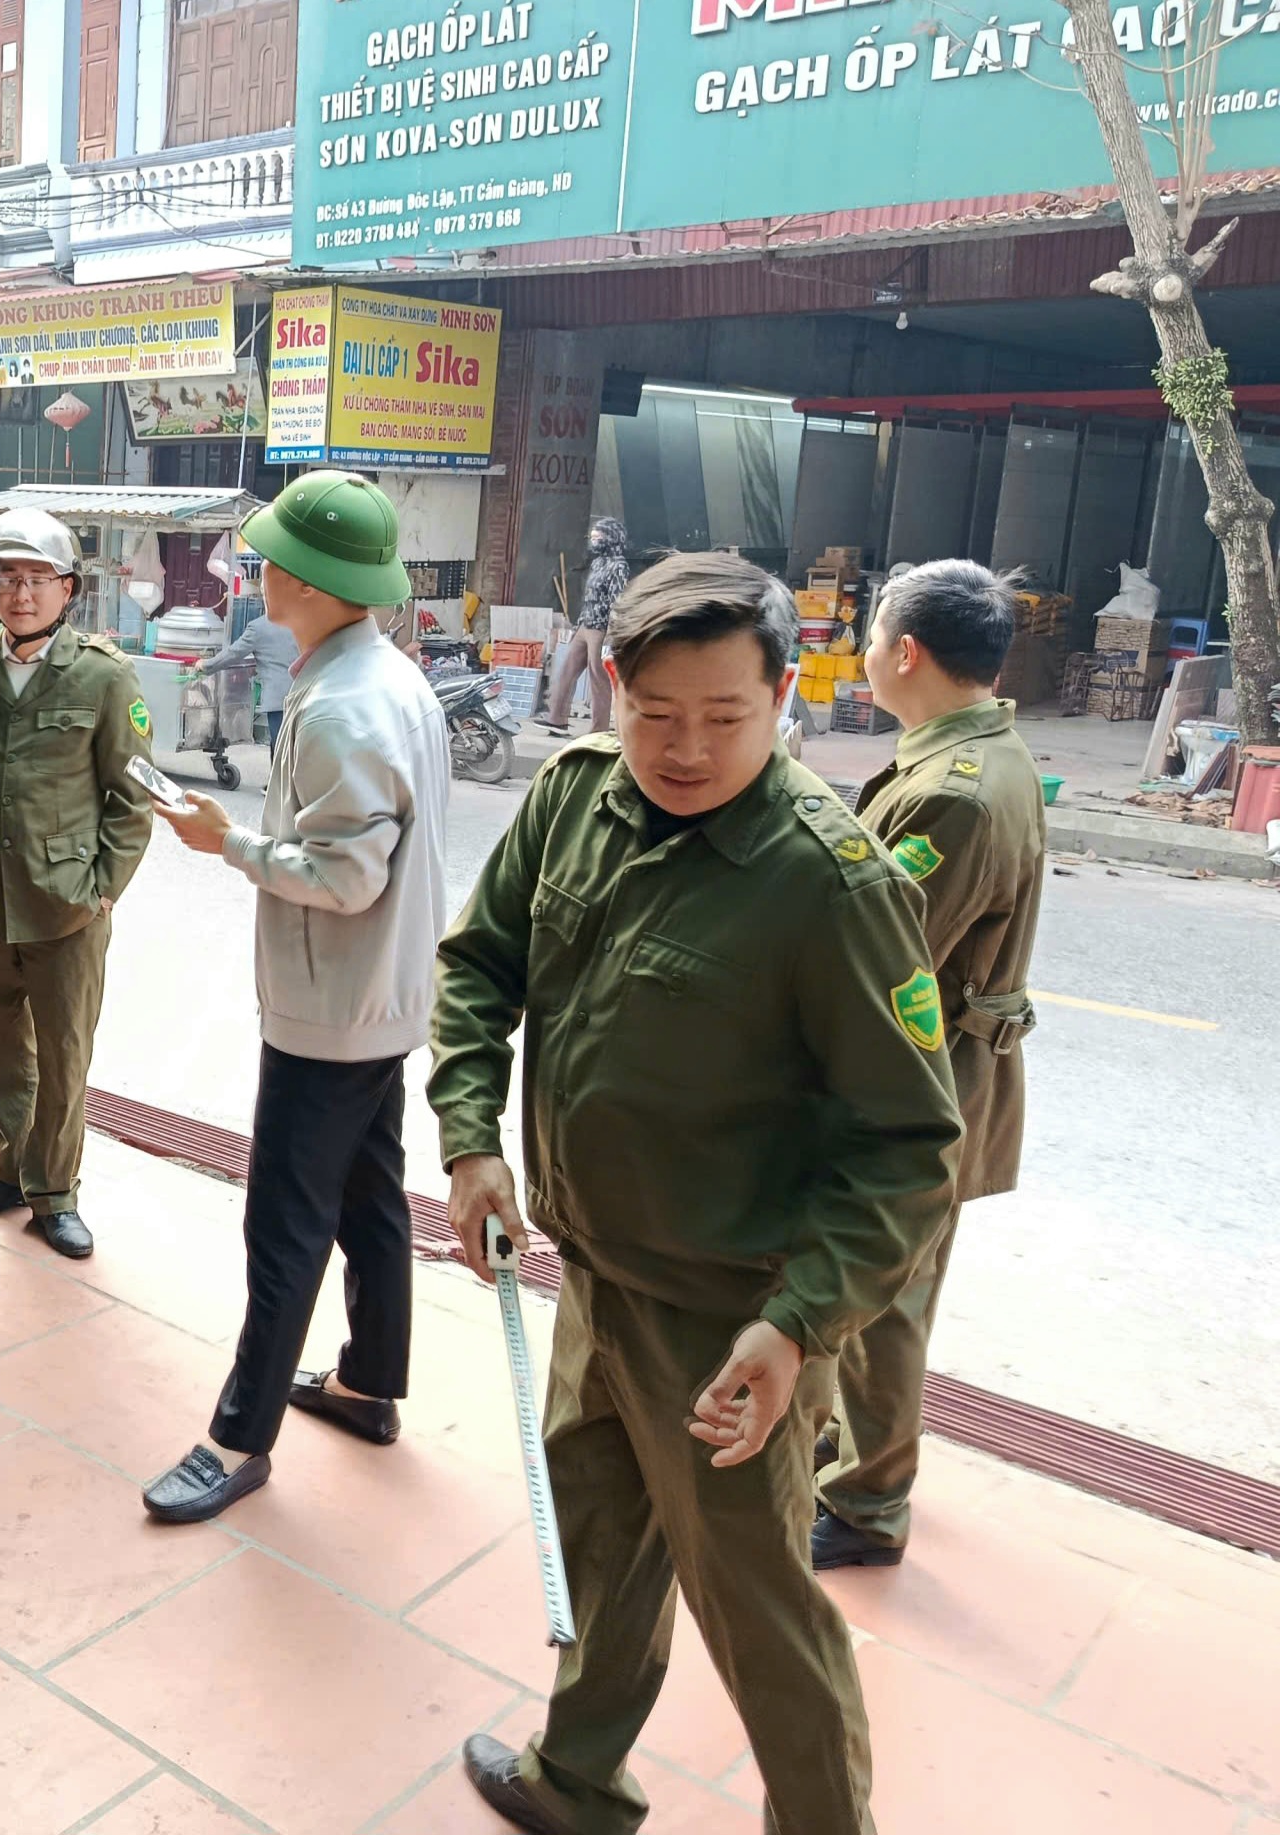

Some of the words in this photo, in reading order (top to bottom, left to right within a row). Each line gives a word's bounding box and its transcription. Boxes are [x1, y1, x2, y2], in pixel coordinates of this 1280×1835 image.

[367, 21, 436, 71] GẠCH
[441, 1, 476, 53] ỐP
[480, 0, 534, 47] LÁT
[319, 75, 376, 123] THIẾT
[381, 81, 403, 117] BỊ
[407, 68, 435, 112] VỆ
[440, 64, 498, 102] SINH
[503, 54, 552, 91] CAO
[557, 31, 609, 81] CẤP
[694, 54, 830, 118] GẠCH
[843, 25, 918, 92] ỐP
[930, 16, 1042, 81] LÁT
[319, 133, 366, 169] SƠN
[509, 96, 601, 140] DULUX
[351, 200, 366, 218] 43
[460, 185, 475, 204] TT
[364, 223, 394, 243] 3788
[434, 215, 466, 235] 0978
[469, 212, 493, 231] 379
[32, 299, 96, 323] KHUNG
[100, 291, 165, 316] TRANH
[440, 308, 471, 331] MINH
[473, 312, 497, 333] SƠN
[80, 329, 97, 348] HUY
[140, 320, 161, 343] CÁC
[162, 321, 183, 345] LOẠI
[185, 318, 219, 339] KHUNG
[276, 316, 326, 350] Sika
[106, 357, 131, 374] DUNG
[343, 340, 363, 381] ĐẠI
[378, 335, 400, 378] CẤP
[415, 341, 480, 387] Sika
[529, 453, 589, 485] KOVA
